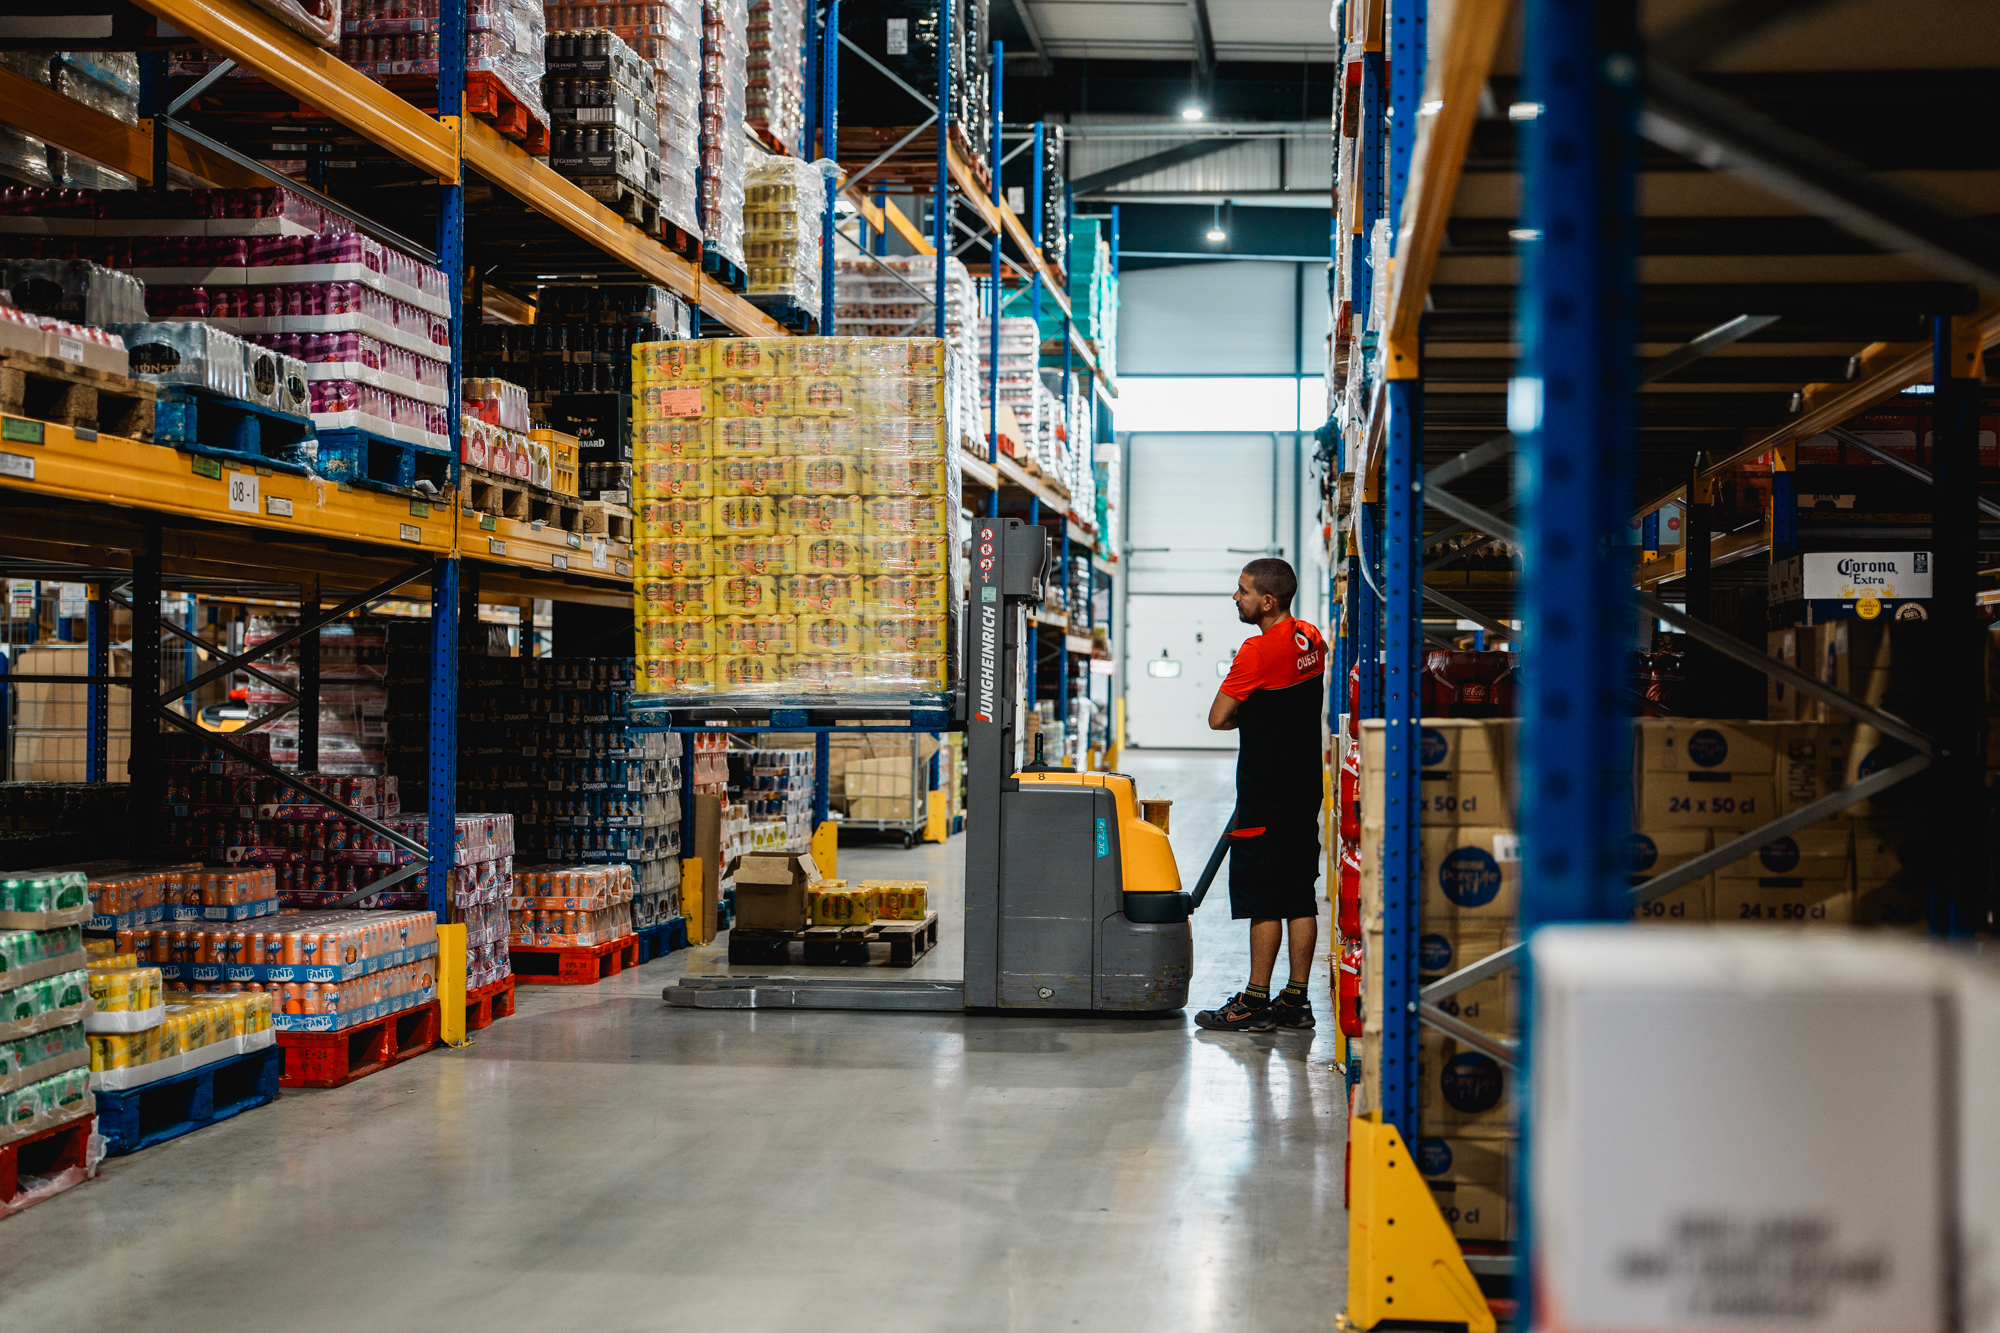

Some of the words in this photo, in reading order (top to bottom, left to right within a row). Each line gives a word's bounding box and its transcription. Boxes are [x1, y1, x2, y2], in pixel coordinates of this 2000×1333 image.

[1837, 558, 1897, 577] Corona
[1853, 574, 1884, 584] Extra
[976, 606, 996, 723] JUNGHEINRICH
[1297, 650, 1318, 670] OUEST
[1038, 773, 1045, 781] 8
[582, 782, 608, 790] ORANGINA
[1435, 795, 1458, 811] 50
[1462, 796, 1476, 811] cl
[1669, 797, 1691, 813] 24
[1698, 801, 1707, 812] x
[1712, 797, 1735, 813] 50
[1740, 797, 1755, 813] cl
[581, 850, 607, 858] ORANGINA
[1098, 841, 1106, 855] EJC
[173, 907, 198, 918] FANTA
[1643, 902, 1665, 917] 50
[1670, 902, 1685, 917] cl
[1740, 903, 1763, 919] 24
[1768, 907, 1777, 919] x
[1783, 903, 1806, 919] 50
[1811, 904, 1826, 919] cl
[86, 916, 111, 927] FANTA
[193, 967, 219, 977] FANTA
[227, 967, 255, 977] FANTA
[267, 968, 294, 979] FANTA
[307, 968, 334, 979] FANTA
[1464, 1003, 1479, 1018] cl
[306, 1016, 333, 1028] FANTA
[1464, 1208, 1480, 1223] cl
